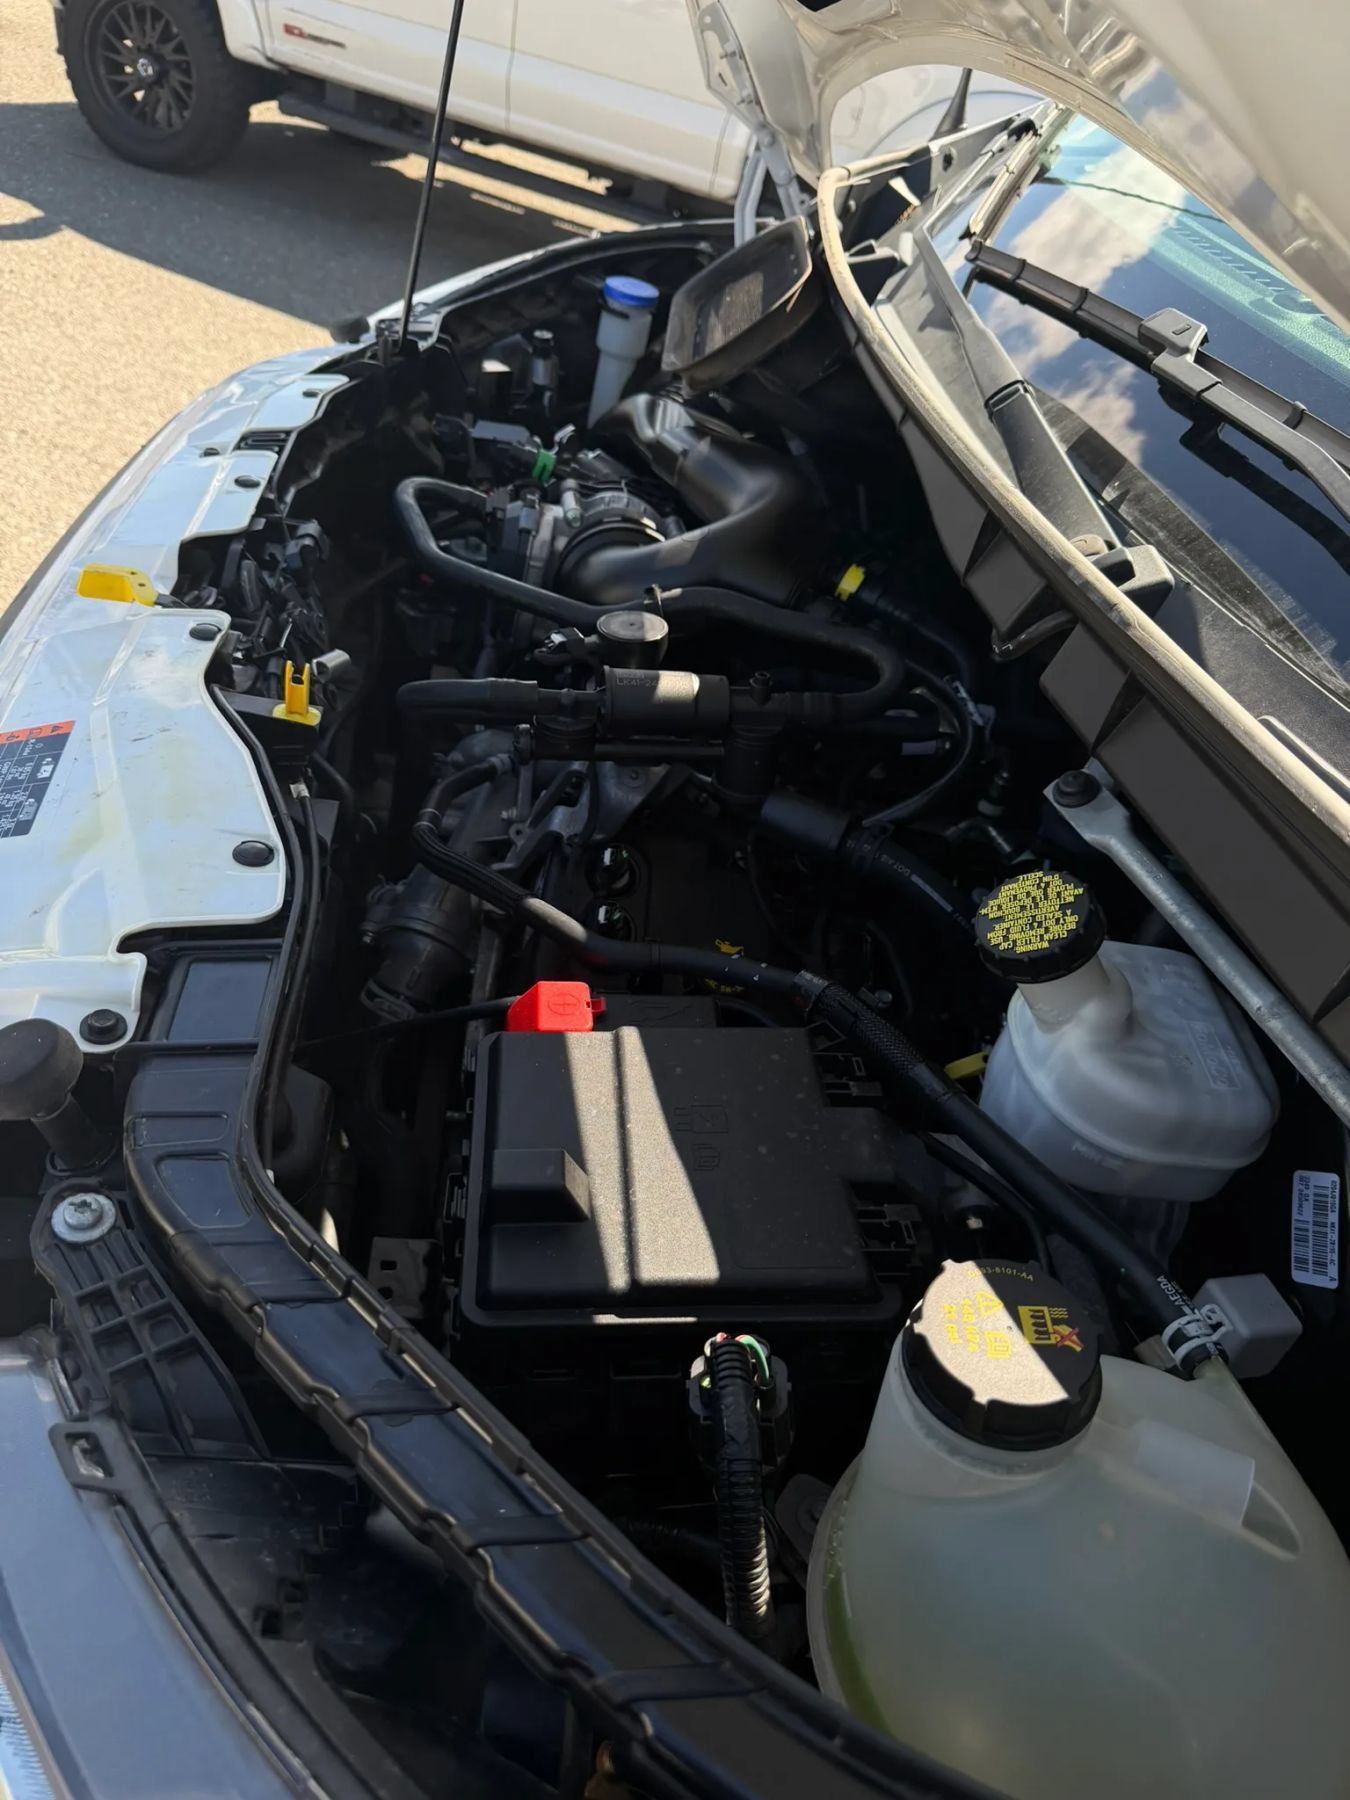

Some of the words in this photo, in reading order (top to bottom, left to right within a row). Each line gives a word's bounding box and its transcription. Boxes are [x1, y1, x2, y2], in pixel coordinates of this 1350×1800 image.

[1001, 879, 1038, 890] CONTENANT
[1047, 883, 1073, 893] PLOYER
[998, 885, 1037, 897] PROVENANT
[1061, 888, 1083, 896] AVANT
[988, 896, 1013, 905] LIQUIDE
[1038, 897, 1074, 907] NETTOYER
[988, 907, 1020, 919] BOUCHON
[1036, 911, 1062, 921] SEALED
[993, 917, 1032, 930] CONTAINER.
[1042, 918, 1055, 927] DOT
[1060, 915, 1078, 923] ONLY
[1009, 924, 1029, 933] FLUID
[1048, 923, 1076, 931] BEFORE
[987, 929, 1006, 939] FROM
[1043, 931, 1067, 940] CLEAN
[989, 937, 1003, 945] USE
[1016, 935, 1040, 945] FILLER
[999, 941, 1012, 950] CAP
[1156, 1274, 1186, 1306] AEGDA
